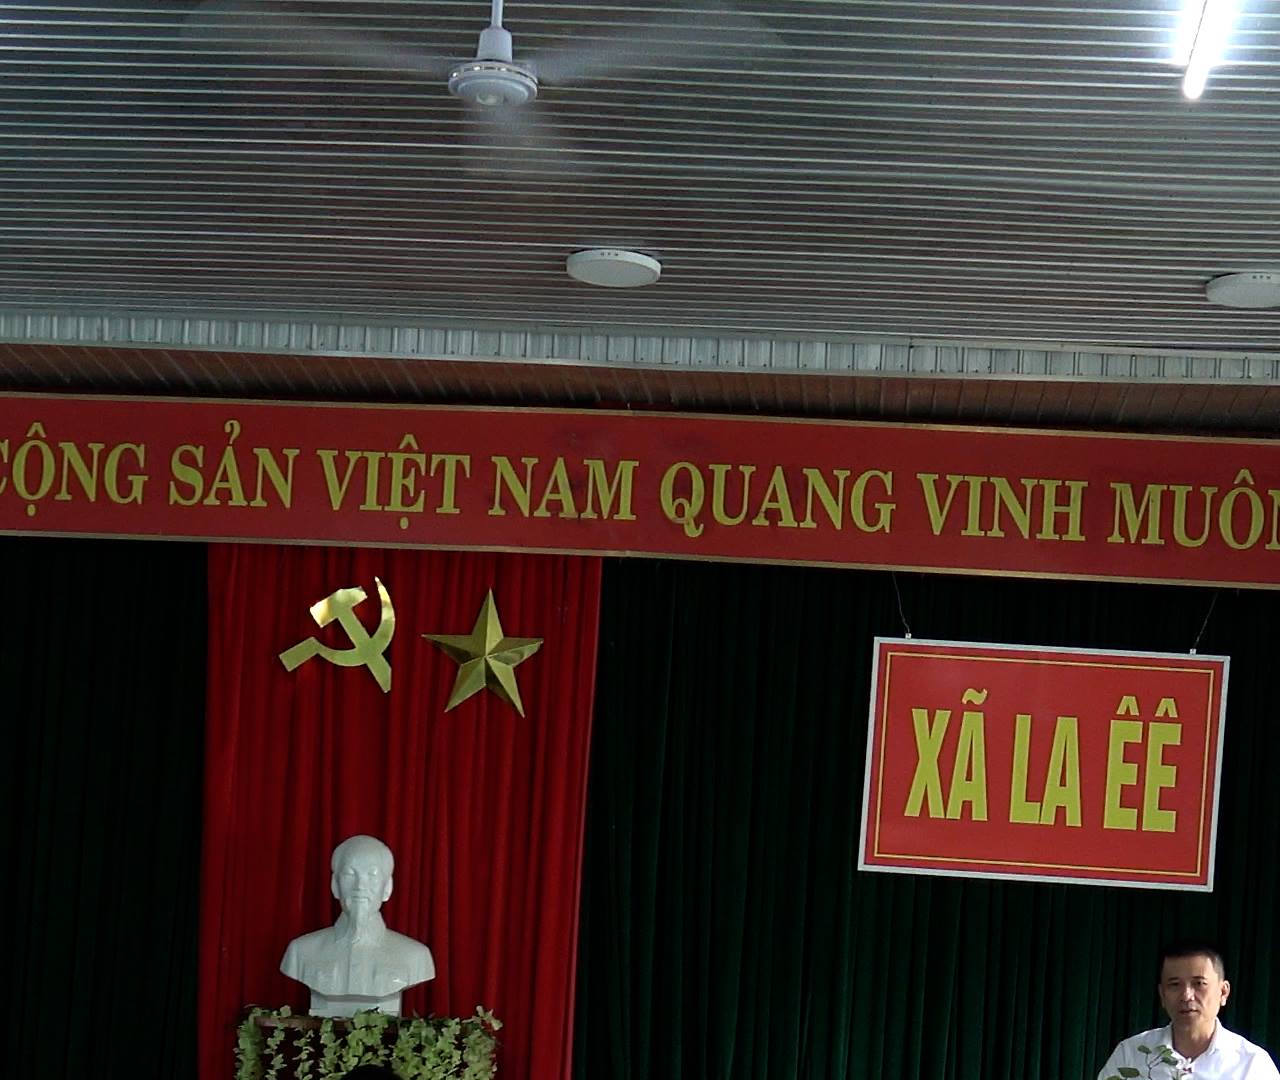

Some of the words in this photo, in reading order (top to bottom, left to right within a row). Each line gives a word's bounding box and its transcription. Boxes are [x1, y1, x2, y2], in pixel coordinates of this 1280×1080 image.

[169, 419, 299, 508] SẢN
[317, 433, 471, 529] VIỆT
[487, 455, 640, 521] NAM
[660, 461, 897, 538] QUANG
[917, 473, 1089, 542] VINH
[904, 687, 989, 822] XÃ
[1008, 713, 1082, 828] LA
[1103, 695, 1183, 833] ÊÊ
